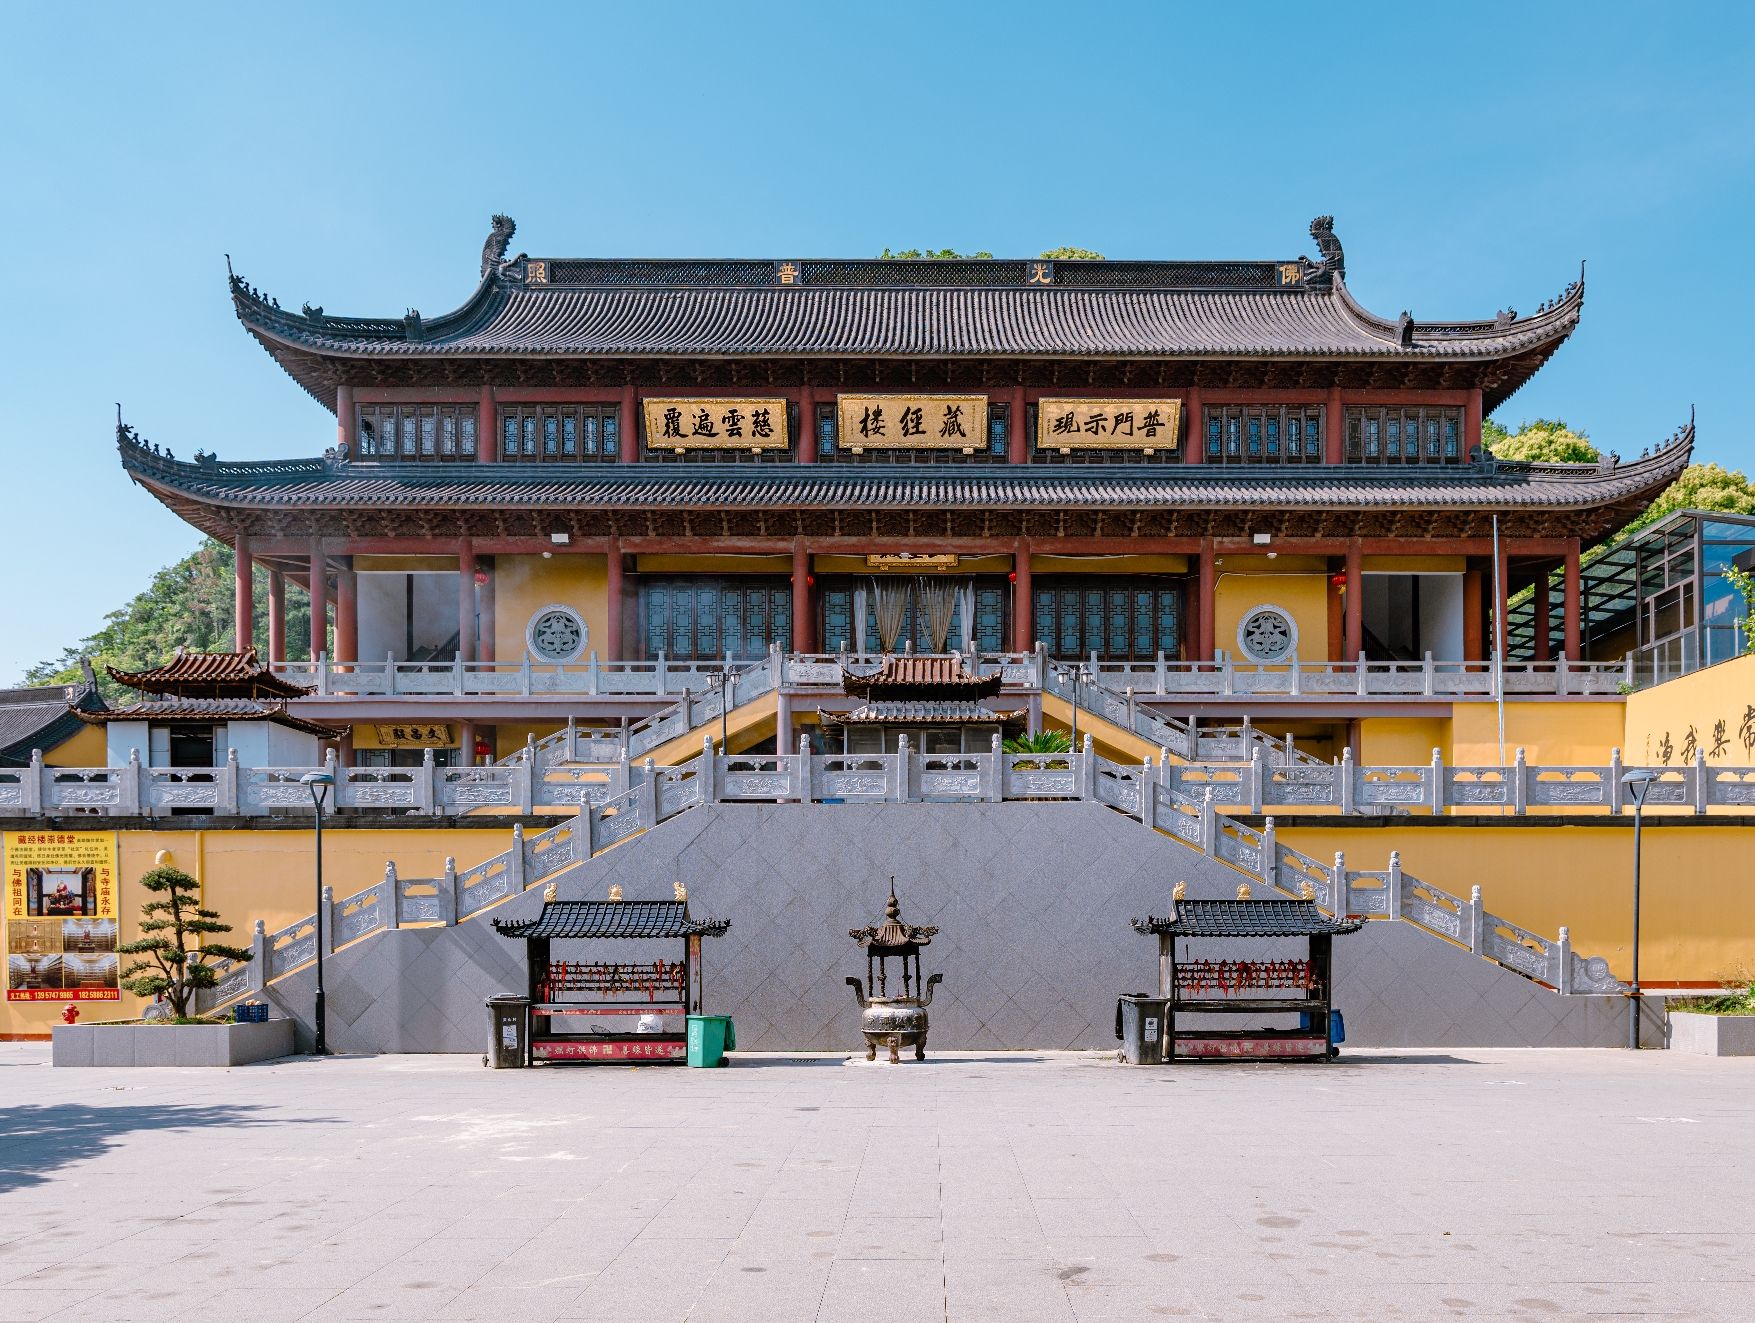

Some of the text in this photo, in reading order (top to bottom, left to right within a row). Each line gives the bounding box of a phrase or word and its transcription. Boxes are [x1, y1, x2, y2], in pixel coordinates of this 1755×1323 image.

[12, 869, 22, 916] 与佛祖同在
[100, 868, 111, 916] 与寺庙永存
